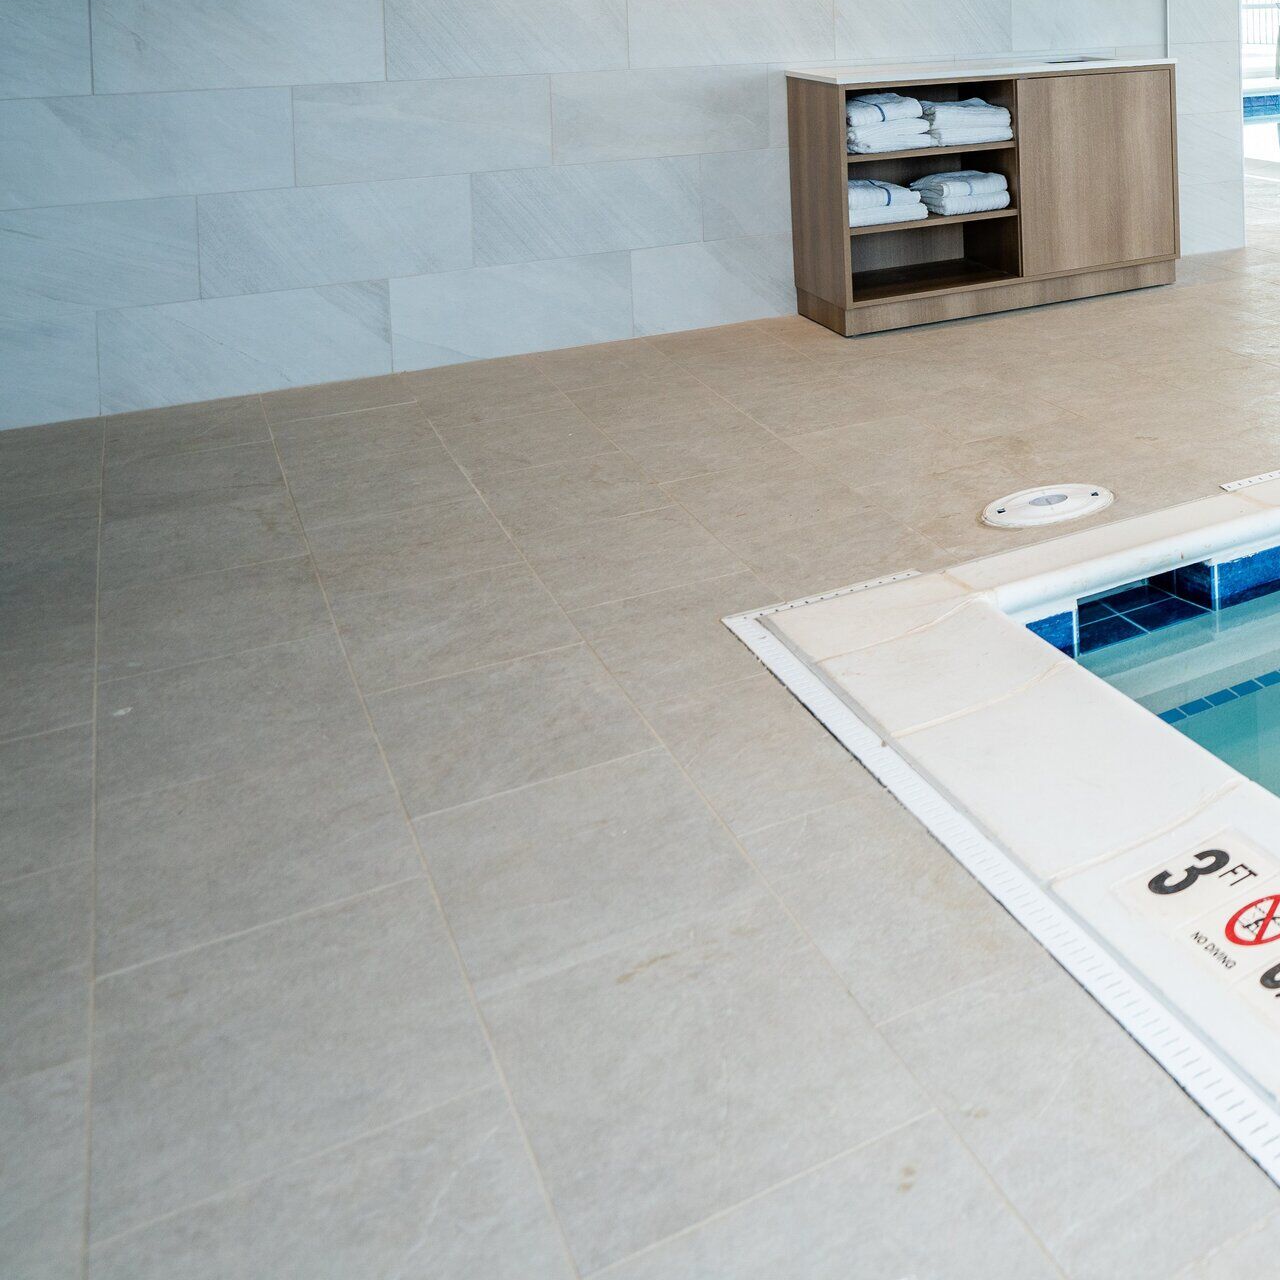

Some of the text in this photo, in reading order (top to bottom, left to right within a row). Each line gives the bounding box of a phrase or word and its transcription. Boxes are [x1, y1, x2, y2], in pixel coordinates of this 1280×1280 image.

[1148, 849, 1258, 895] 3 FT
[1191, 930, 1236, 969] NO DIVING
